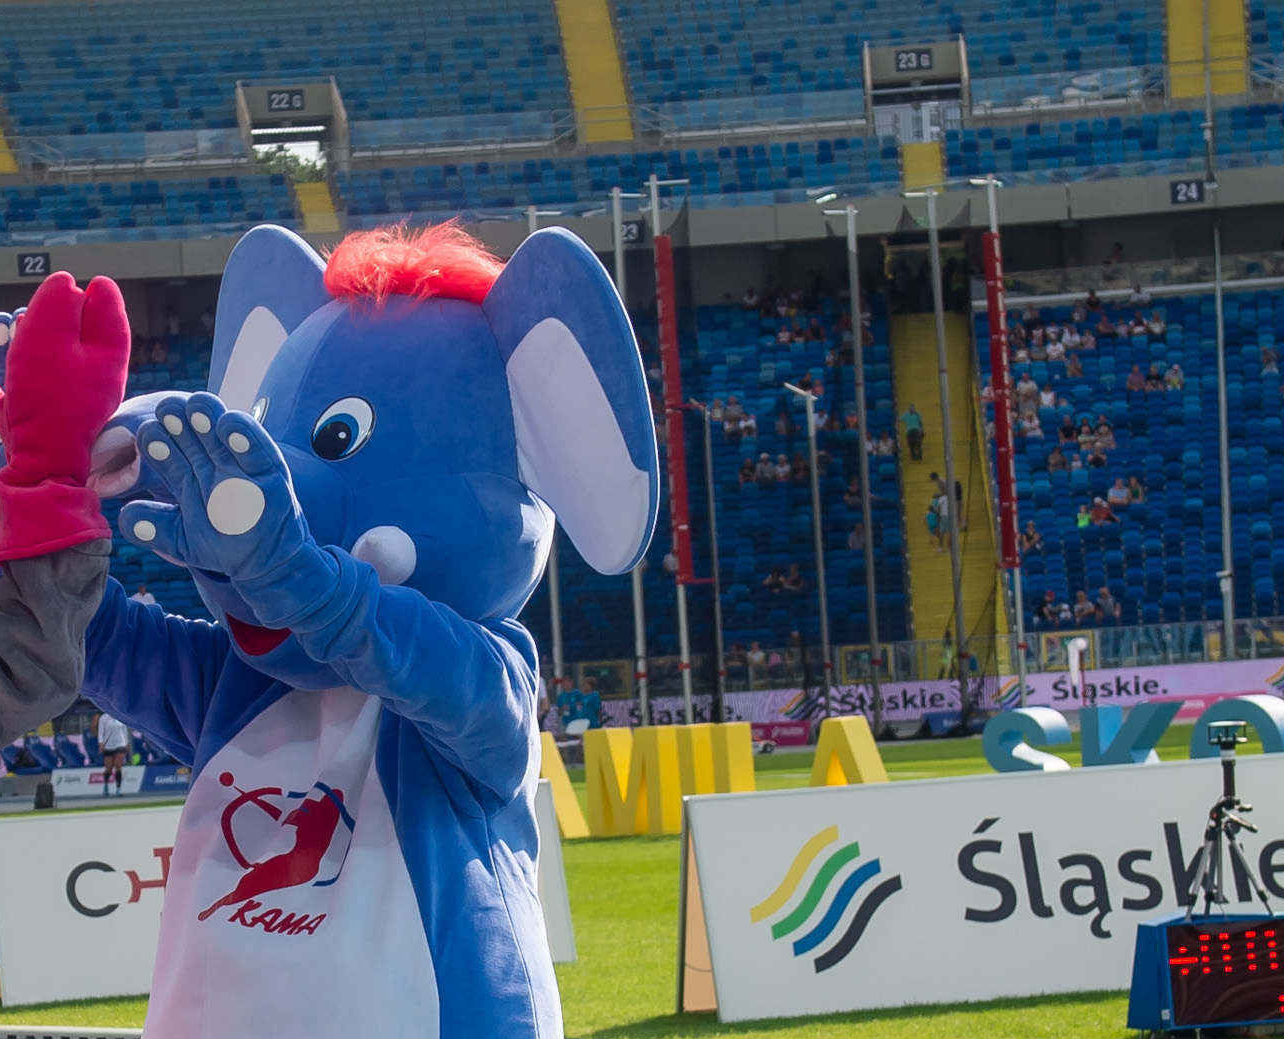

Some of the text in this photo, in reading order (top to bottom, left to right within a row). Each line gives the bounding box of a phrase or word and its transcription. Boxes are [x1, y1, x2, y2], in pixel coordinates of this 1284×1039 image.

[898, 53, 916, 69] 23
[270, 93, 302, 109] 22 G
[1177, 182, 1198, 201] 24
[24, 255, 45, 274] 22
[228, 899, 327, 936] KAMA
